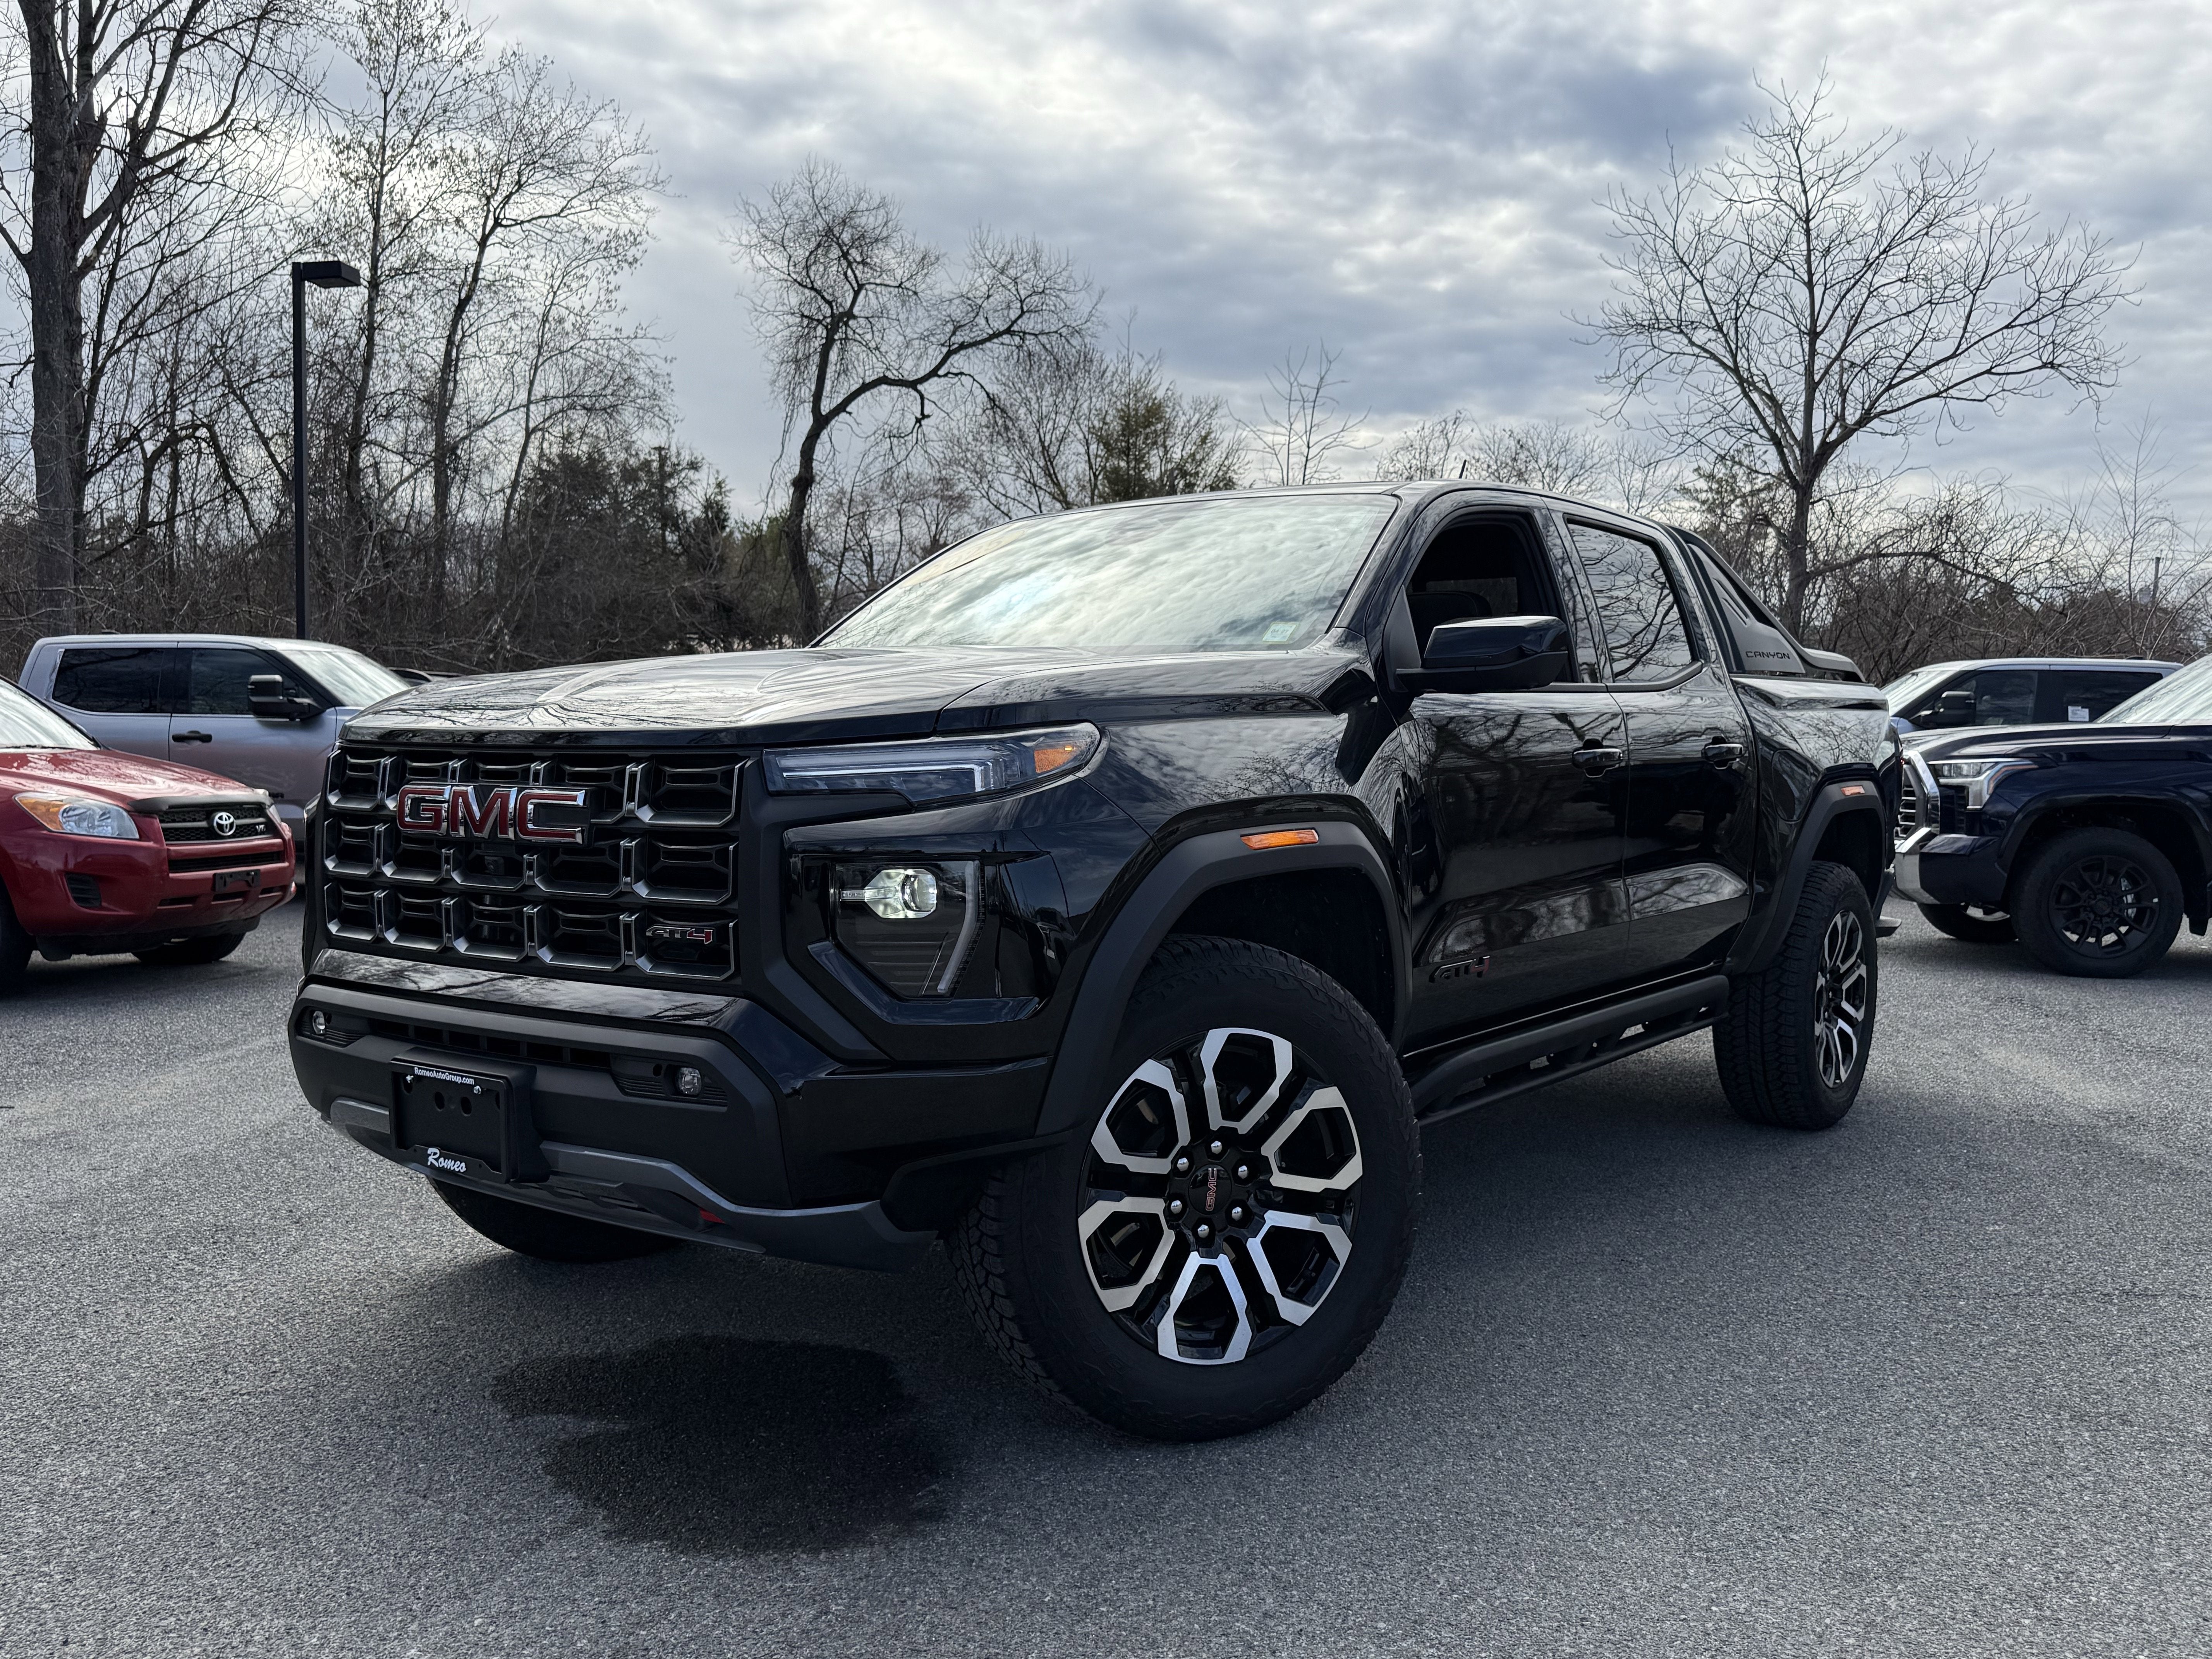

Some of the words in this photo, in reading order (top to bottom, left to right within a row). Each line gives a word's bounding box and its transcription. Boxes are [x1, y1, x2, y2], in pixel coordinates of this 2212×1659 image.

[1745, 651, 1790, 659] CANYON
[397, 785, 585, 844] GMC
[646, 926, 713, 944] AT4
[1428, 956, 1490, 983] AT4
[414, 1066, 474, 1085] RomeoAutoGroup.com
[427, 1148, 466, 1173] Romeo
[1206, 1168, 1217, 1211] GMC
